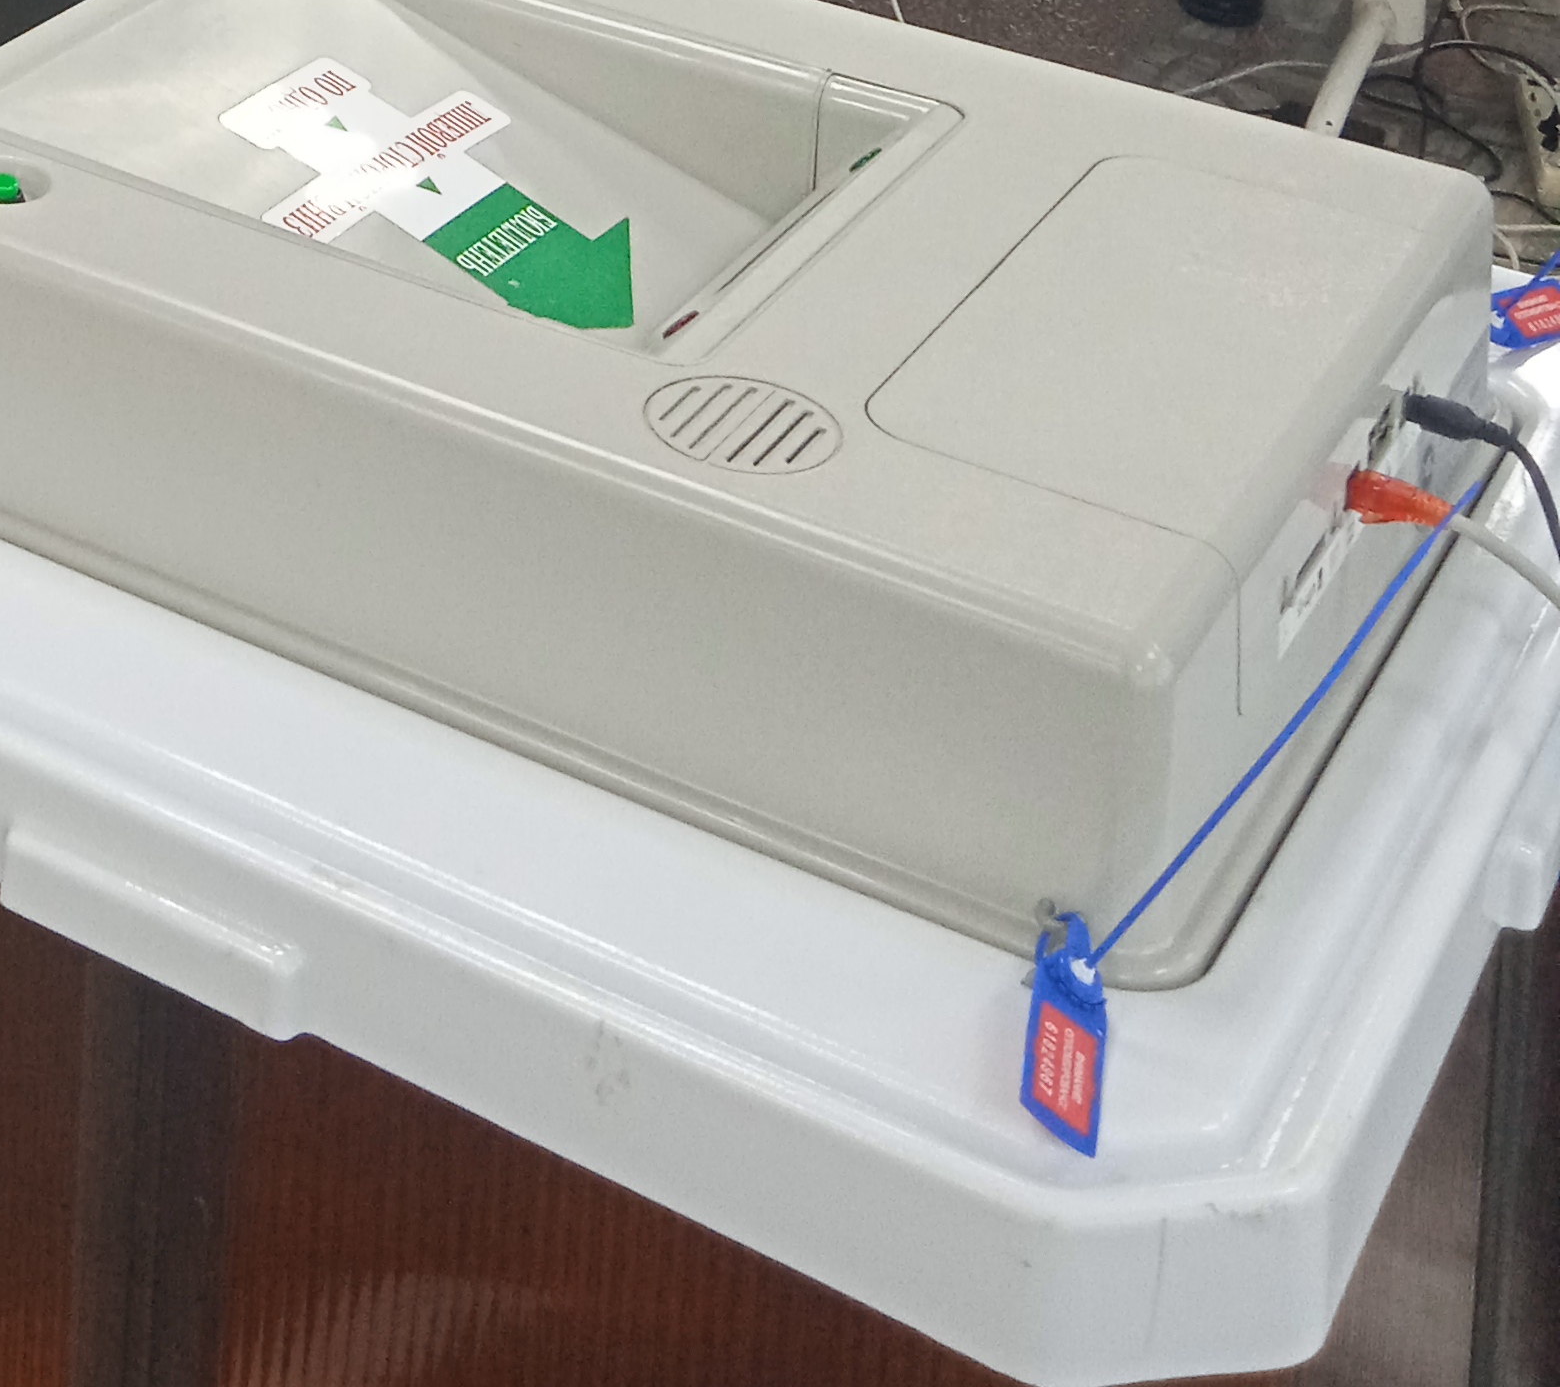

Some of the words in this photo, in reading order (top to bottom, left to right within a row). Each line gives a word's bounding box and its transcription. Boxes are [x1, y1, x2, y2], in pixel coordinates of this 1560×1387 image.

[314, 70, 357, 98] ПО
[415, 100, 492, 159] ЛИЦЕВОЙ
[456, 205, 558, 277] БЮЛЛЕТЕНЬ
